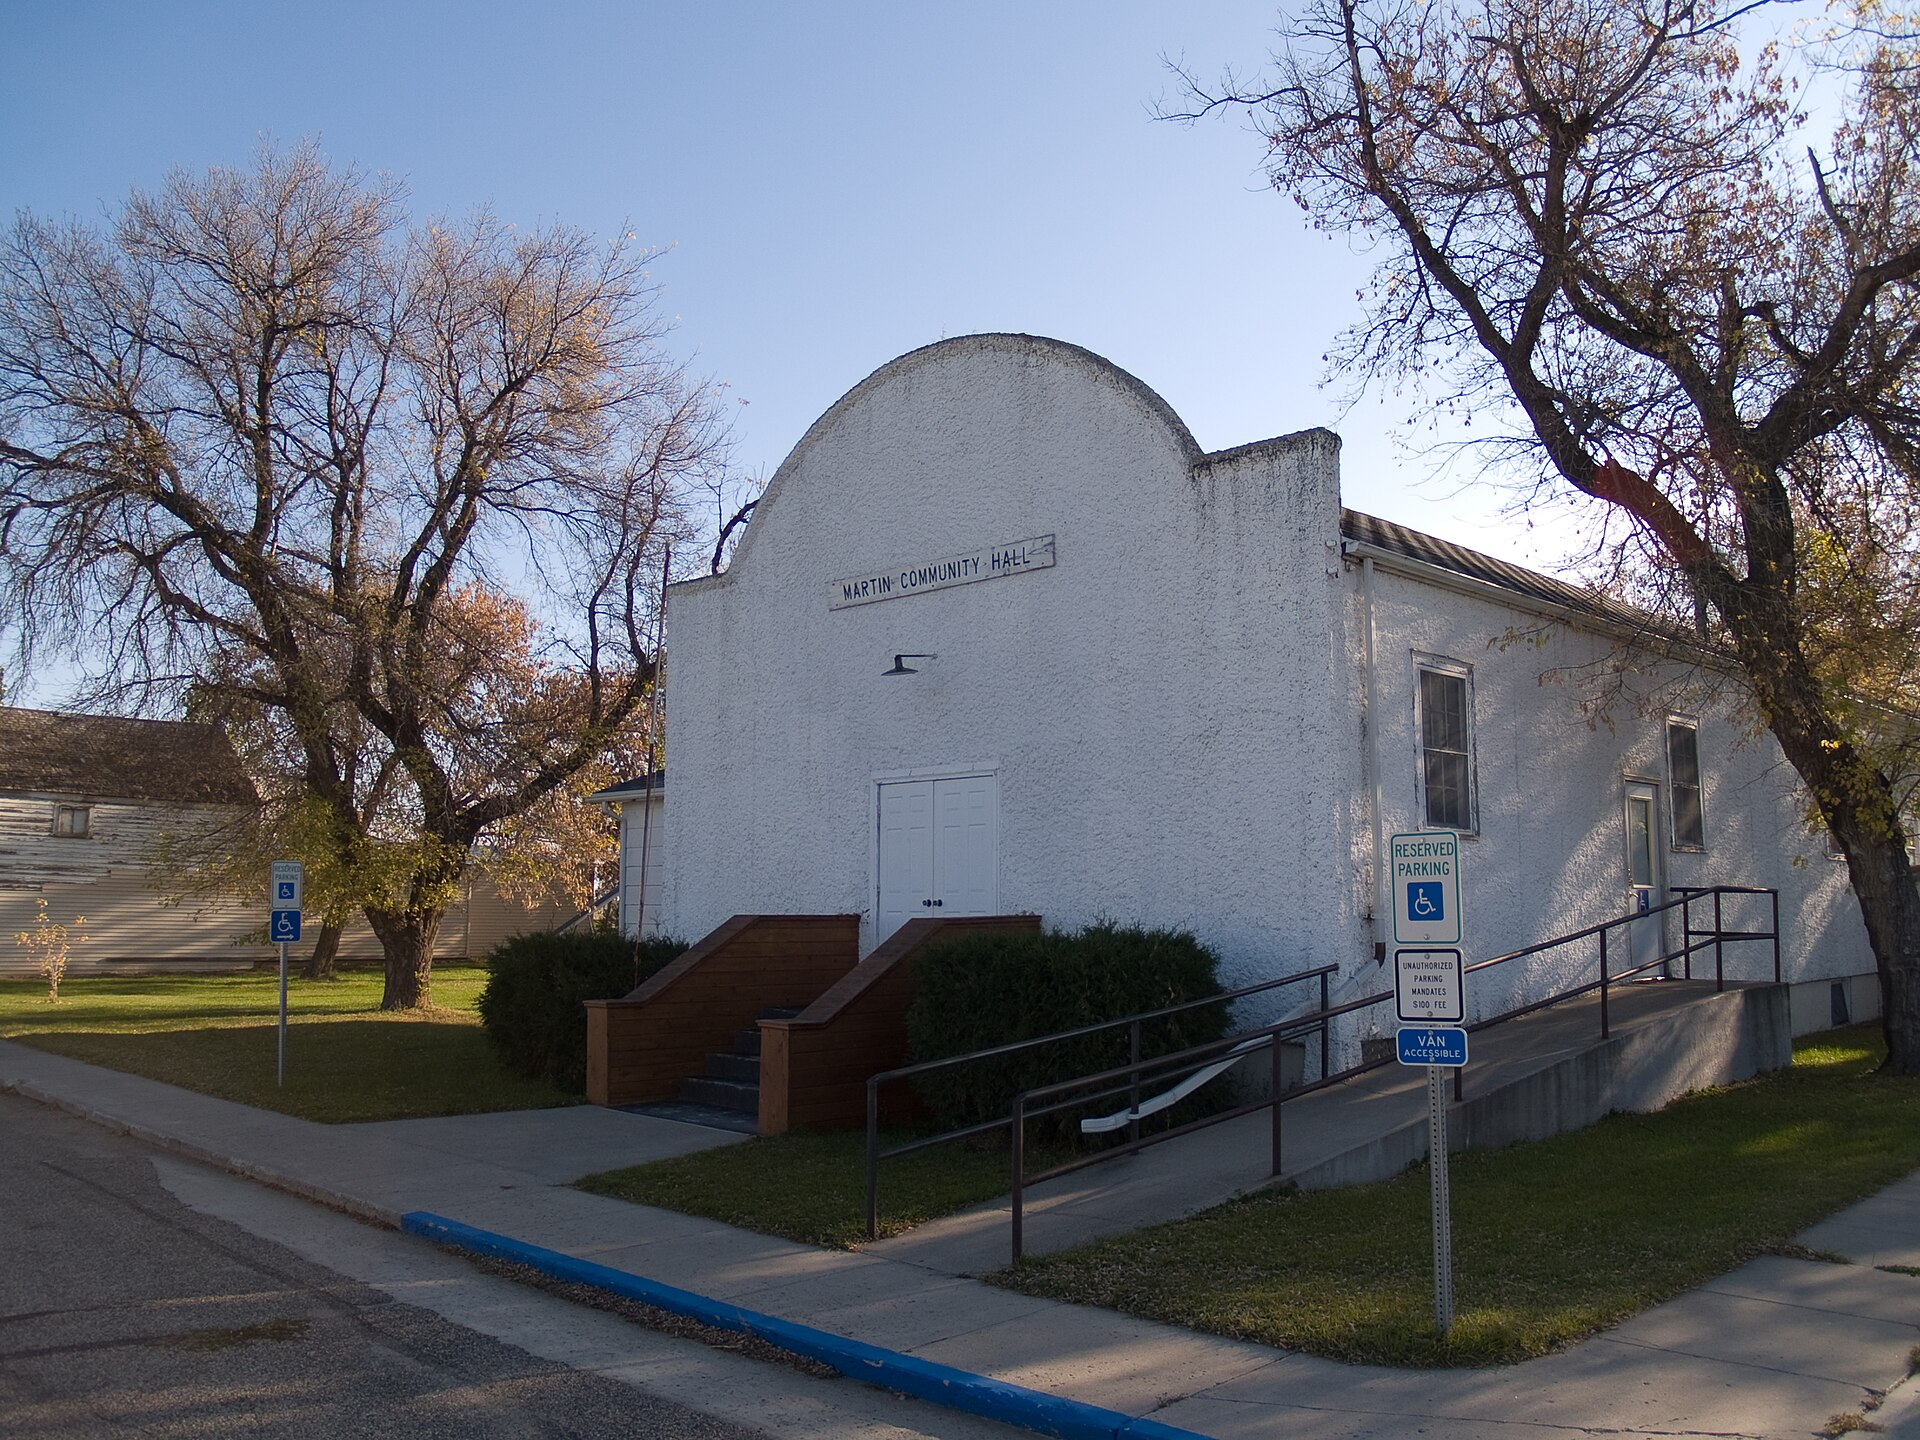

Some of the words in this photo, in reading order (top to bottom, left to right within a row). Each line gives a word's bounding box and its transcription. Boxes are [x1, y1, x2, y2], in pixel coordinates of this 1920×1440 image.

[843, 575, 892, 600] MARTIN
[900, 557, 981, 589] COMMUNITY
[991, 547, 1031, 570] HALL
[1395, 842, 1454, 857] RESERVED
[1398, 861, 1450, 876] PARKING
[1402, 962, 1453, 970] UNAUTHORIZED
[1414, 975, 1443, 983] PARKING
[1411, 988, 1447, 996] MANDATES
[1418, 1036, 1446, 1047] VAN
[1404, 1049, 1461, 1058] ACCESSIBLE
